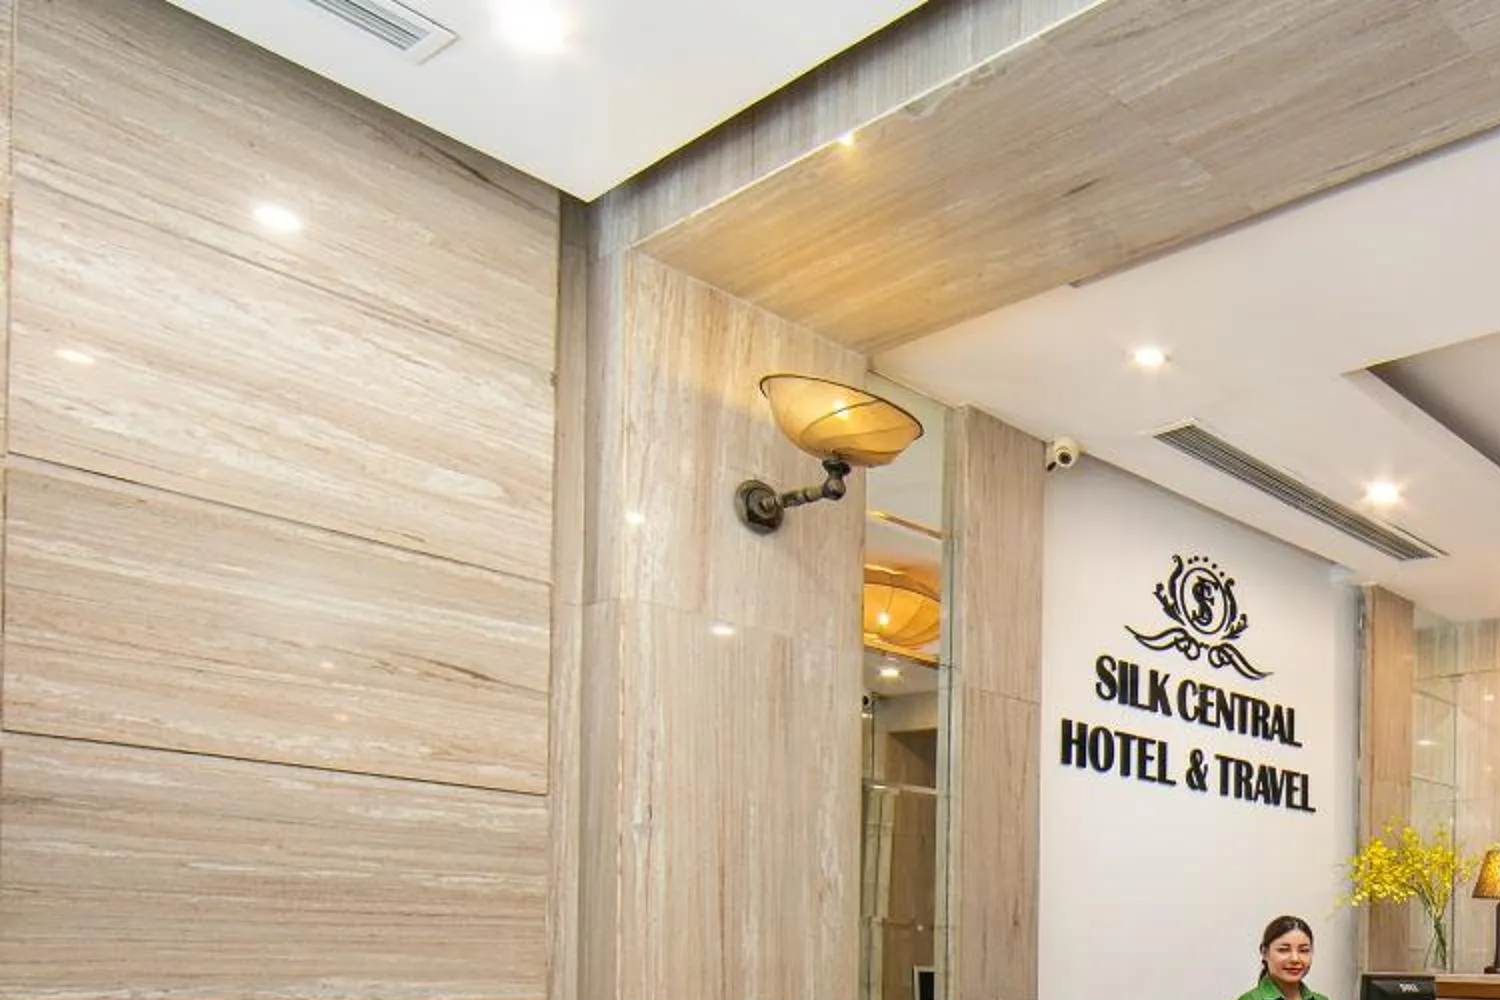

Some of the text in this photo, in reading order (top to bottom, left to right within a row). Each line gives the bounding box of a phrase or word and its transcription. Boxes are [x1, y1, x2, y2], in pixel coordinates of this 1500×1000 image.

[1095, 655, 1303, 748] SILK CENTRAL
[1060, 718, 1317, 813] HOTEL & TRAVEL
